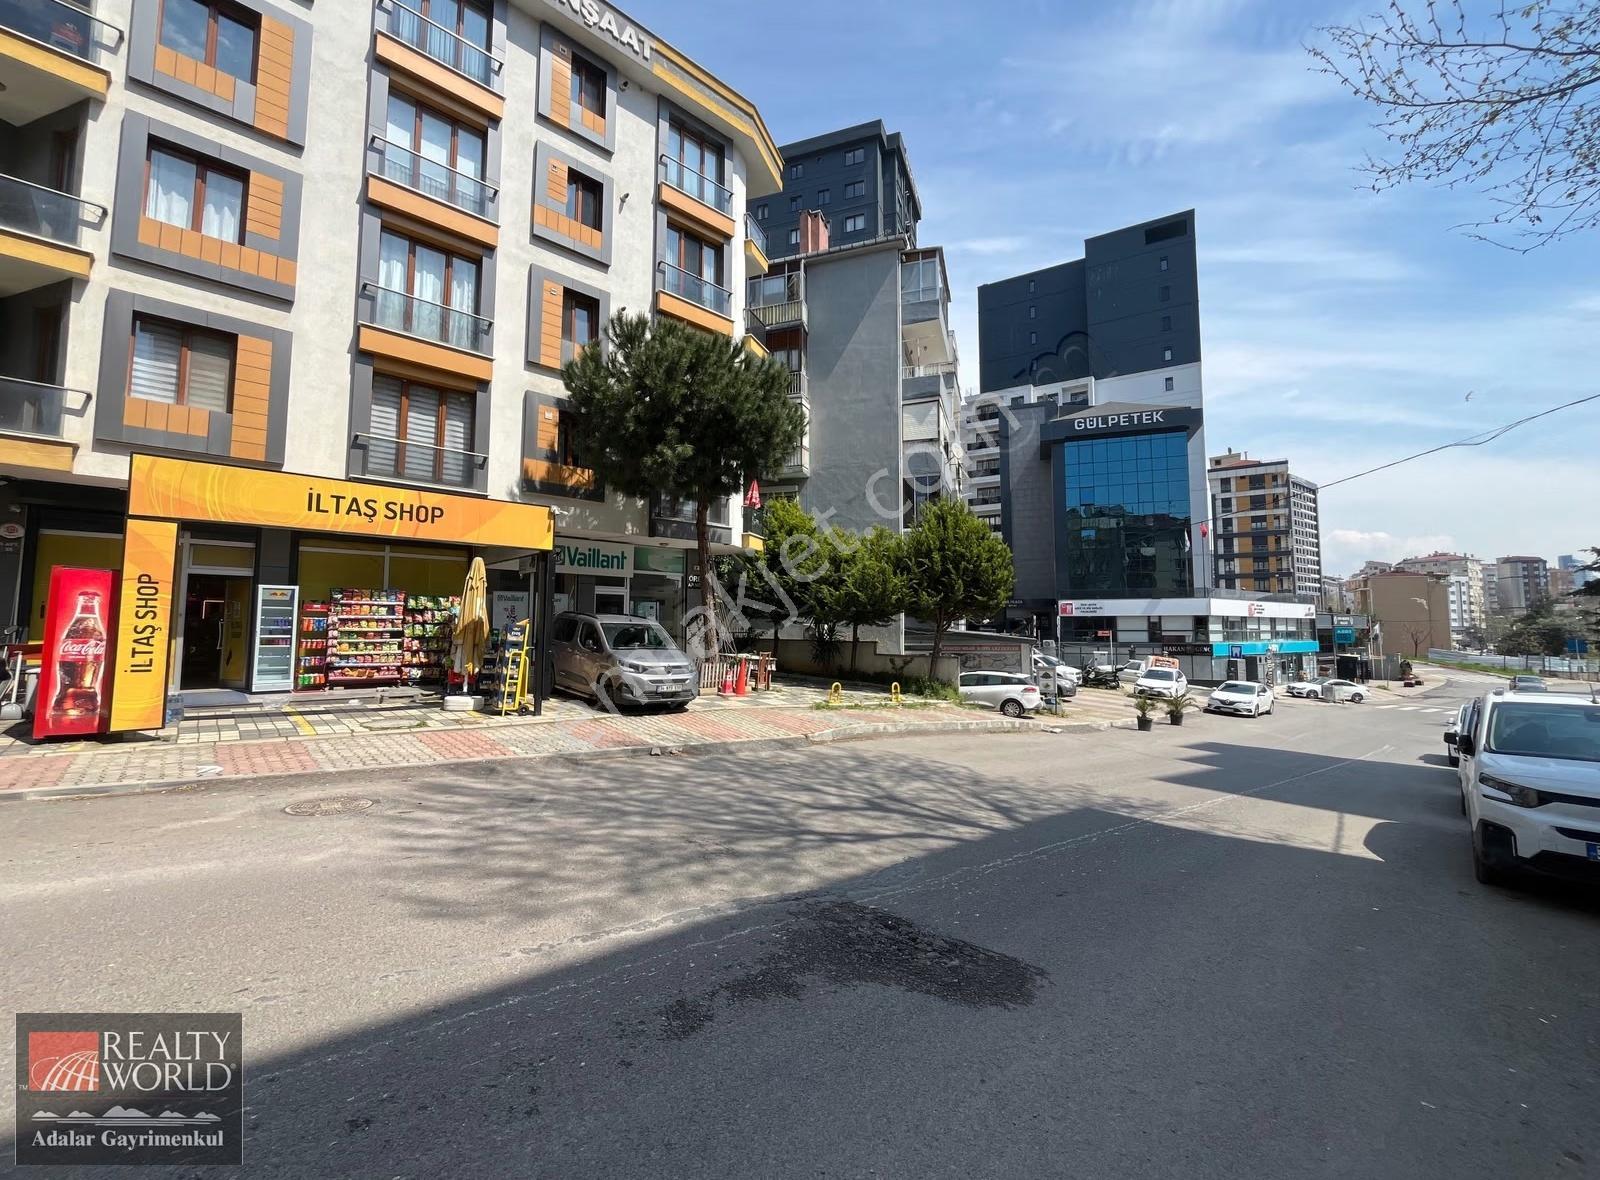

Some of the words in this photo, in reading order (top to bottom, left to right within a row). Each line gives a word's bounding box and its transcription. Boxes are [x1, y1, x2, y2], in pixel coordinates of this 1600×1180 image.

[1074, 410, 1164, 430] GÜLPETEK
[307, 487, 378, 523] İLTAŞ
[383, 501, 445, 524] SHOP
[566, 546, 628, 570] Vaillant
[134, 573, 160, 620] SHOP
[60, 639, 105, 655] Coca-Cola
[124, 624, 162, 673] İLTAŞ
